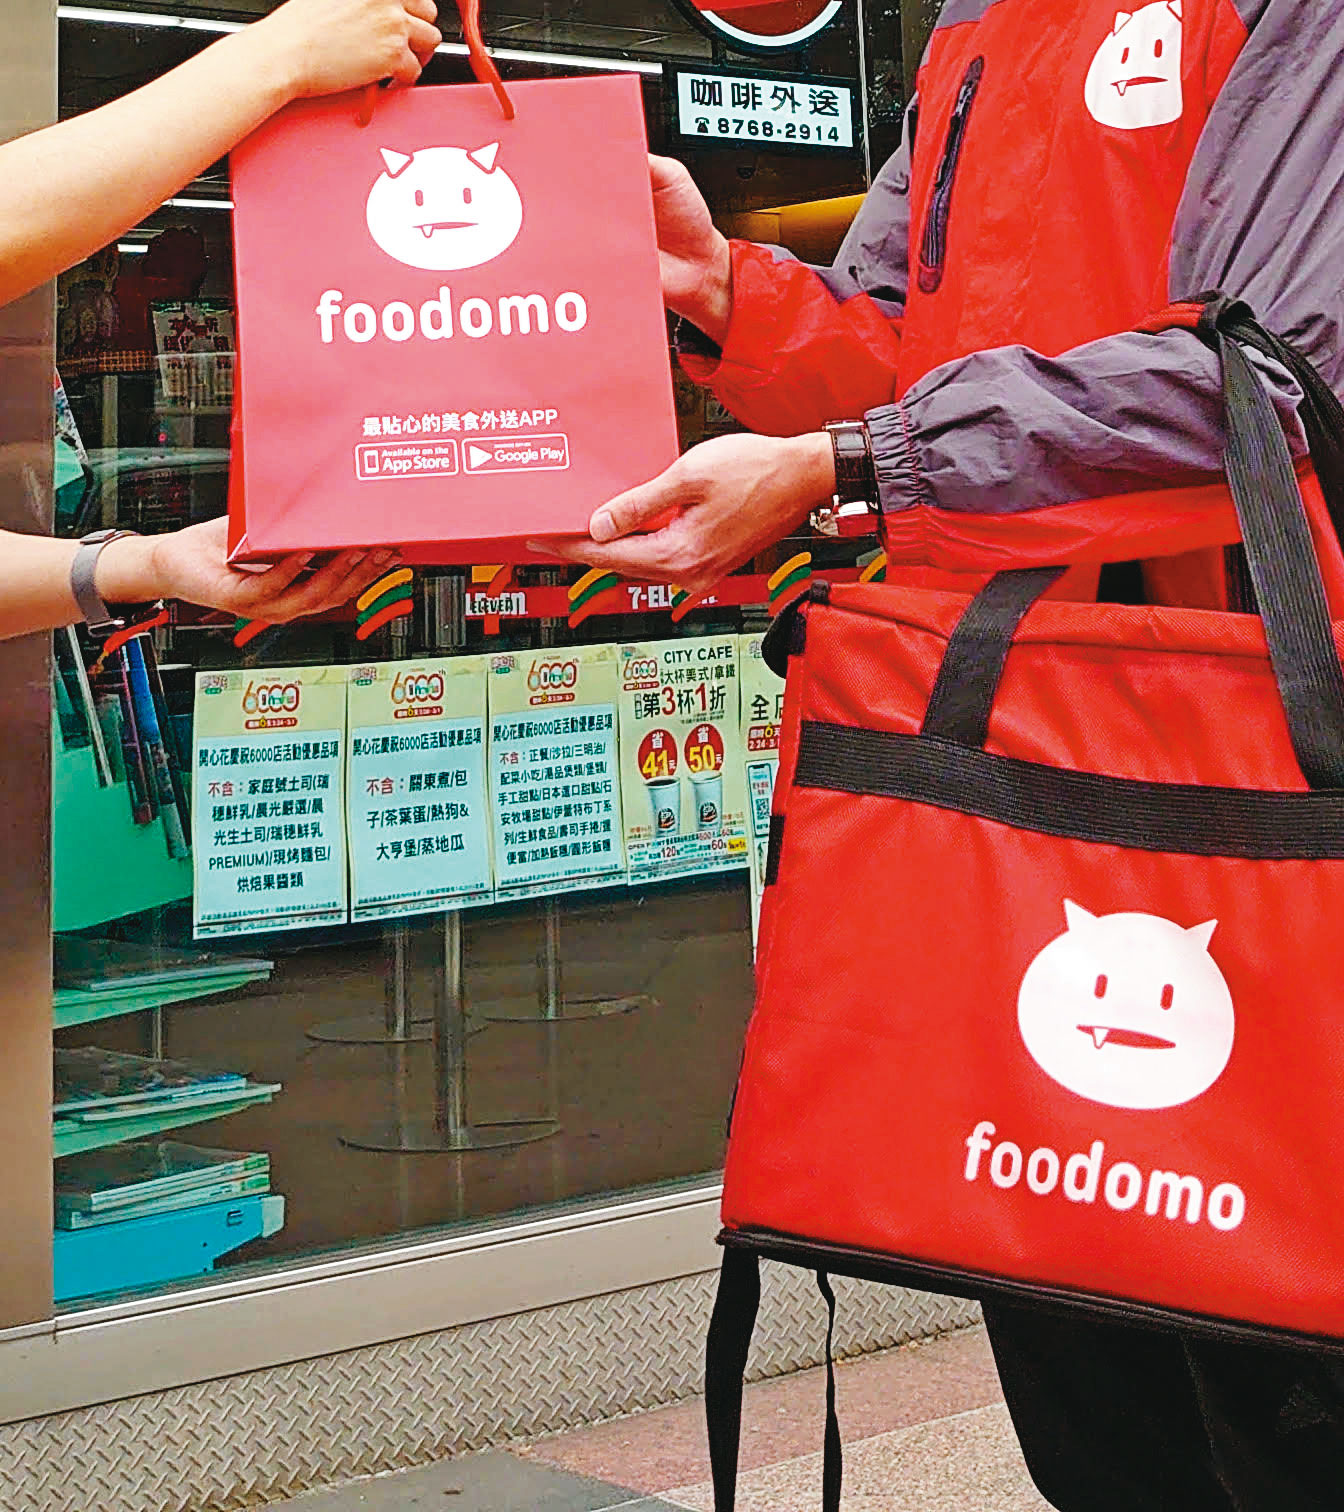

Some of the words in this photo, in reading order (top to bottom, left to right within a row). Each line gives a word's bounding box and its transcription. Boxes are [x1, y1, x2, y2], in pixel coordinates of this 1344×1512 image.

[691, 78, 840, 117] 咖啡外送
[315, 285, 588, 344] foodomo
[382, 457, 413, 473] App
[414, 455, 450, 469] Store
[494, 448, 538, 464] Google
[540, 446, 565, 463] Play
[664, 648, 693, 664] CITY
[697, 645, 733, 661] CAFE
[642, 682, 727, 718] 第3杯1折
[964, 1120, 1246, 1231] foodomo
